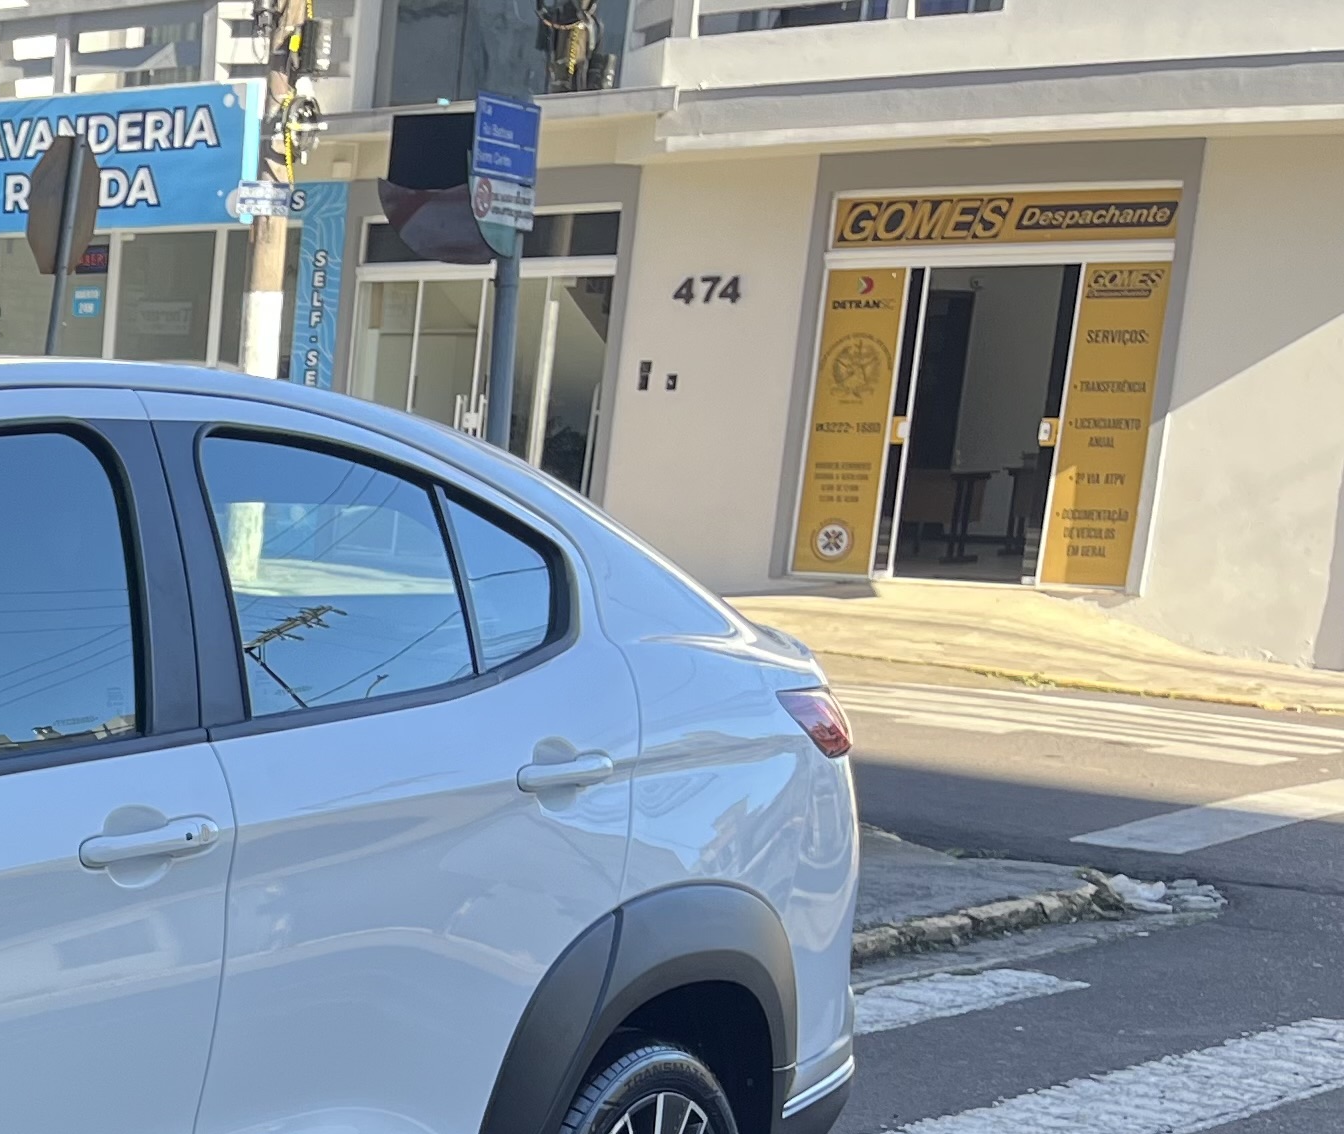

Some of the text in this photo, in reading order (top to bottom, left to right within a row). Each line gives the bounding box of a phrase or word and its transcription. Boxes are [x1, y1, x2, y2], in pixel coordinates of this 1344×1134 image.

[3, 165, 159, 213] RDA
[841, 198, 1172, 242] GOMES Despachante
[673, 275, 741, 304] 474
